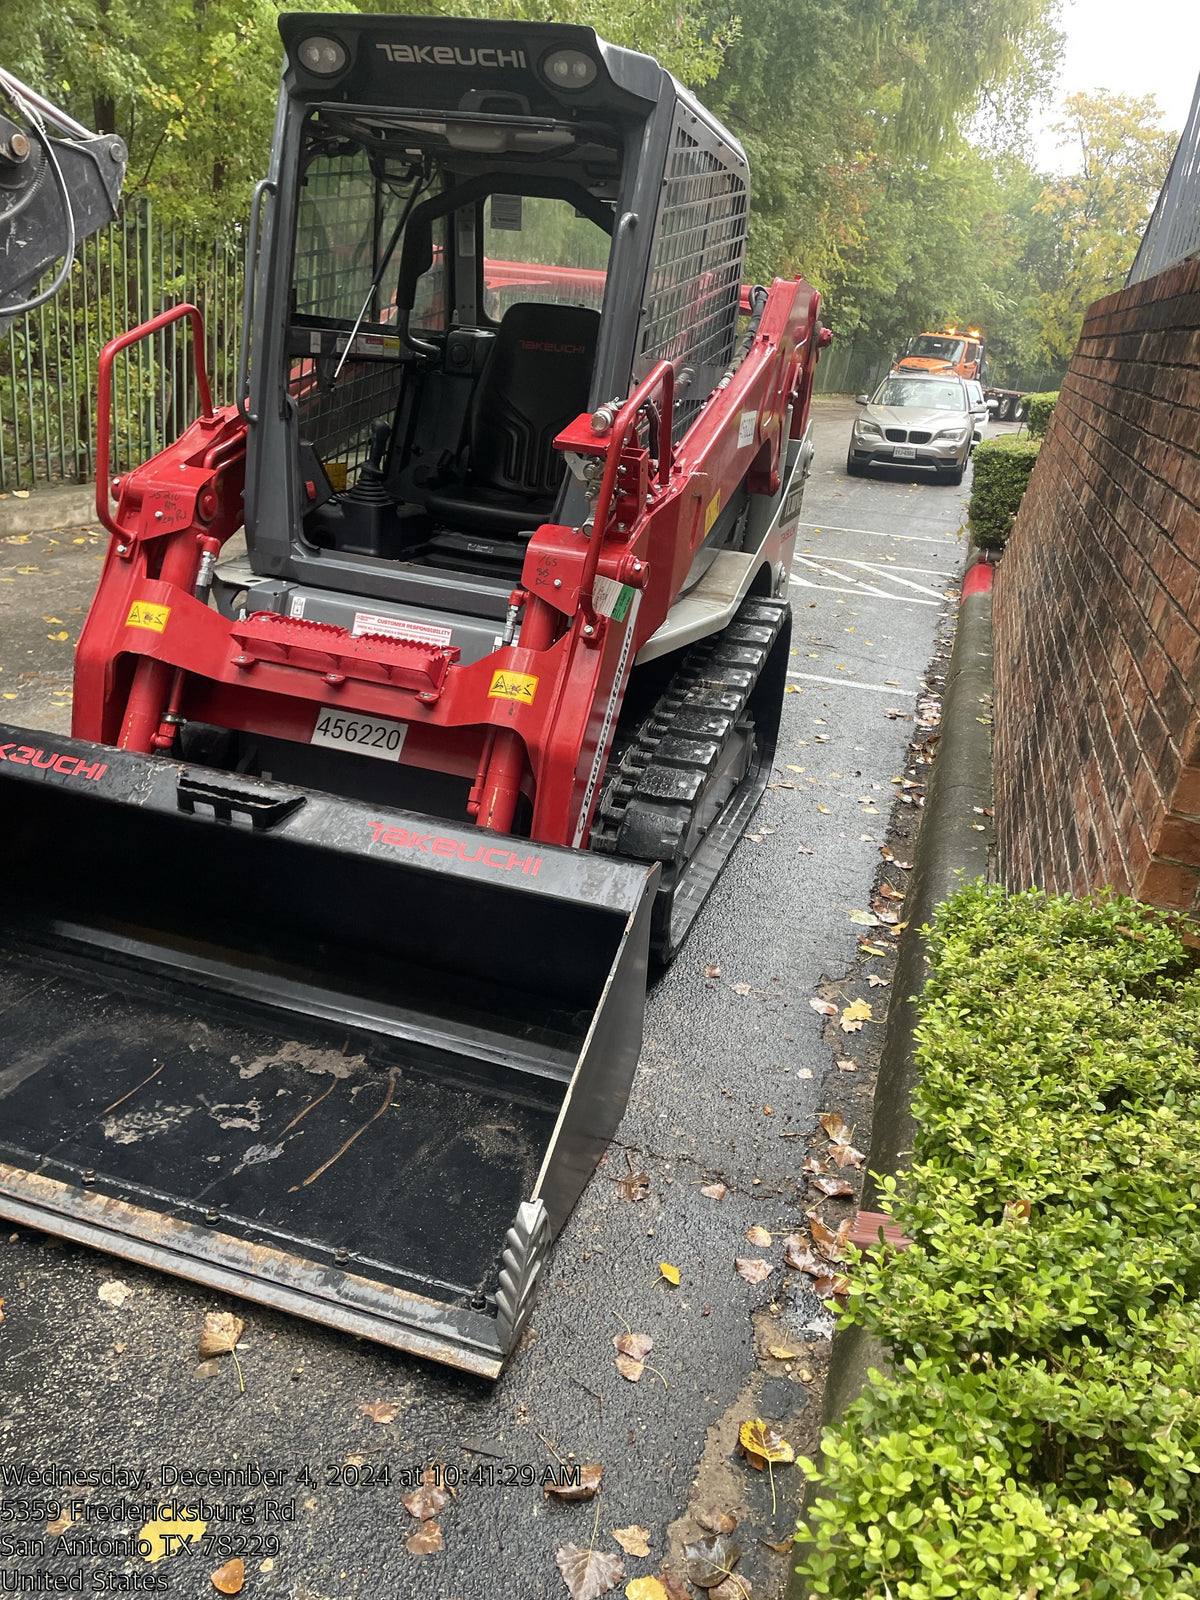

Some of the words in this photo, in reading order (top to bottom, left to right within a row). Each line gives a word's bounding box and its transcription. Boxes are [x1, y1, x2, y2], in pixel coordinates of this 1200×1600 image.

[377, 618, 405, 627] CUSTOMER
[406, 623, 451, 636] RESPONSIBILITY
[316, 716, 401, 751] 456220
